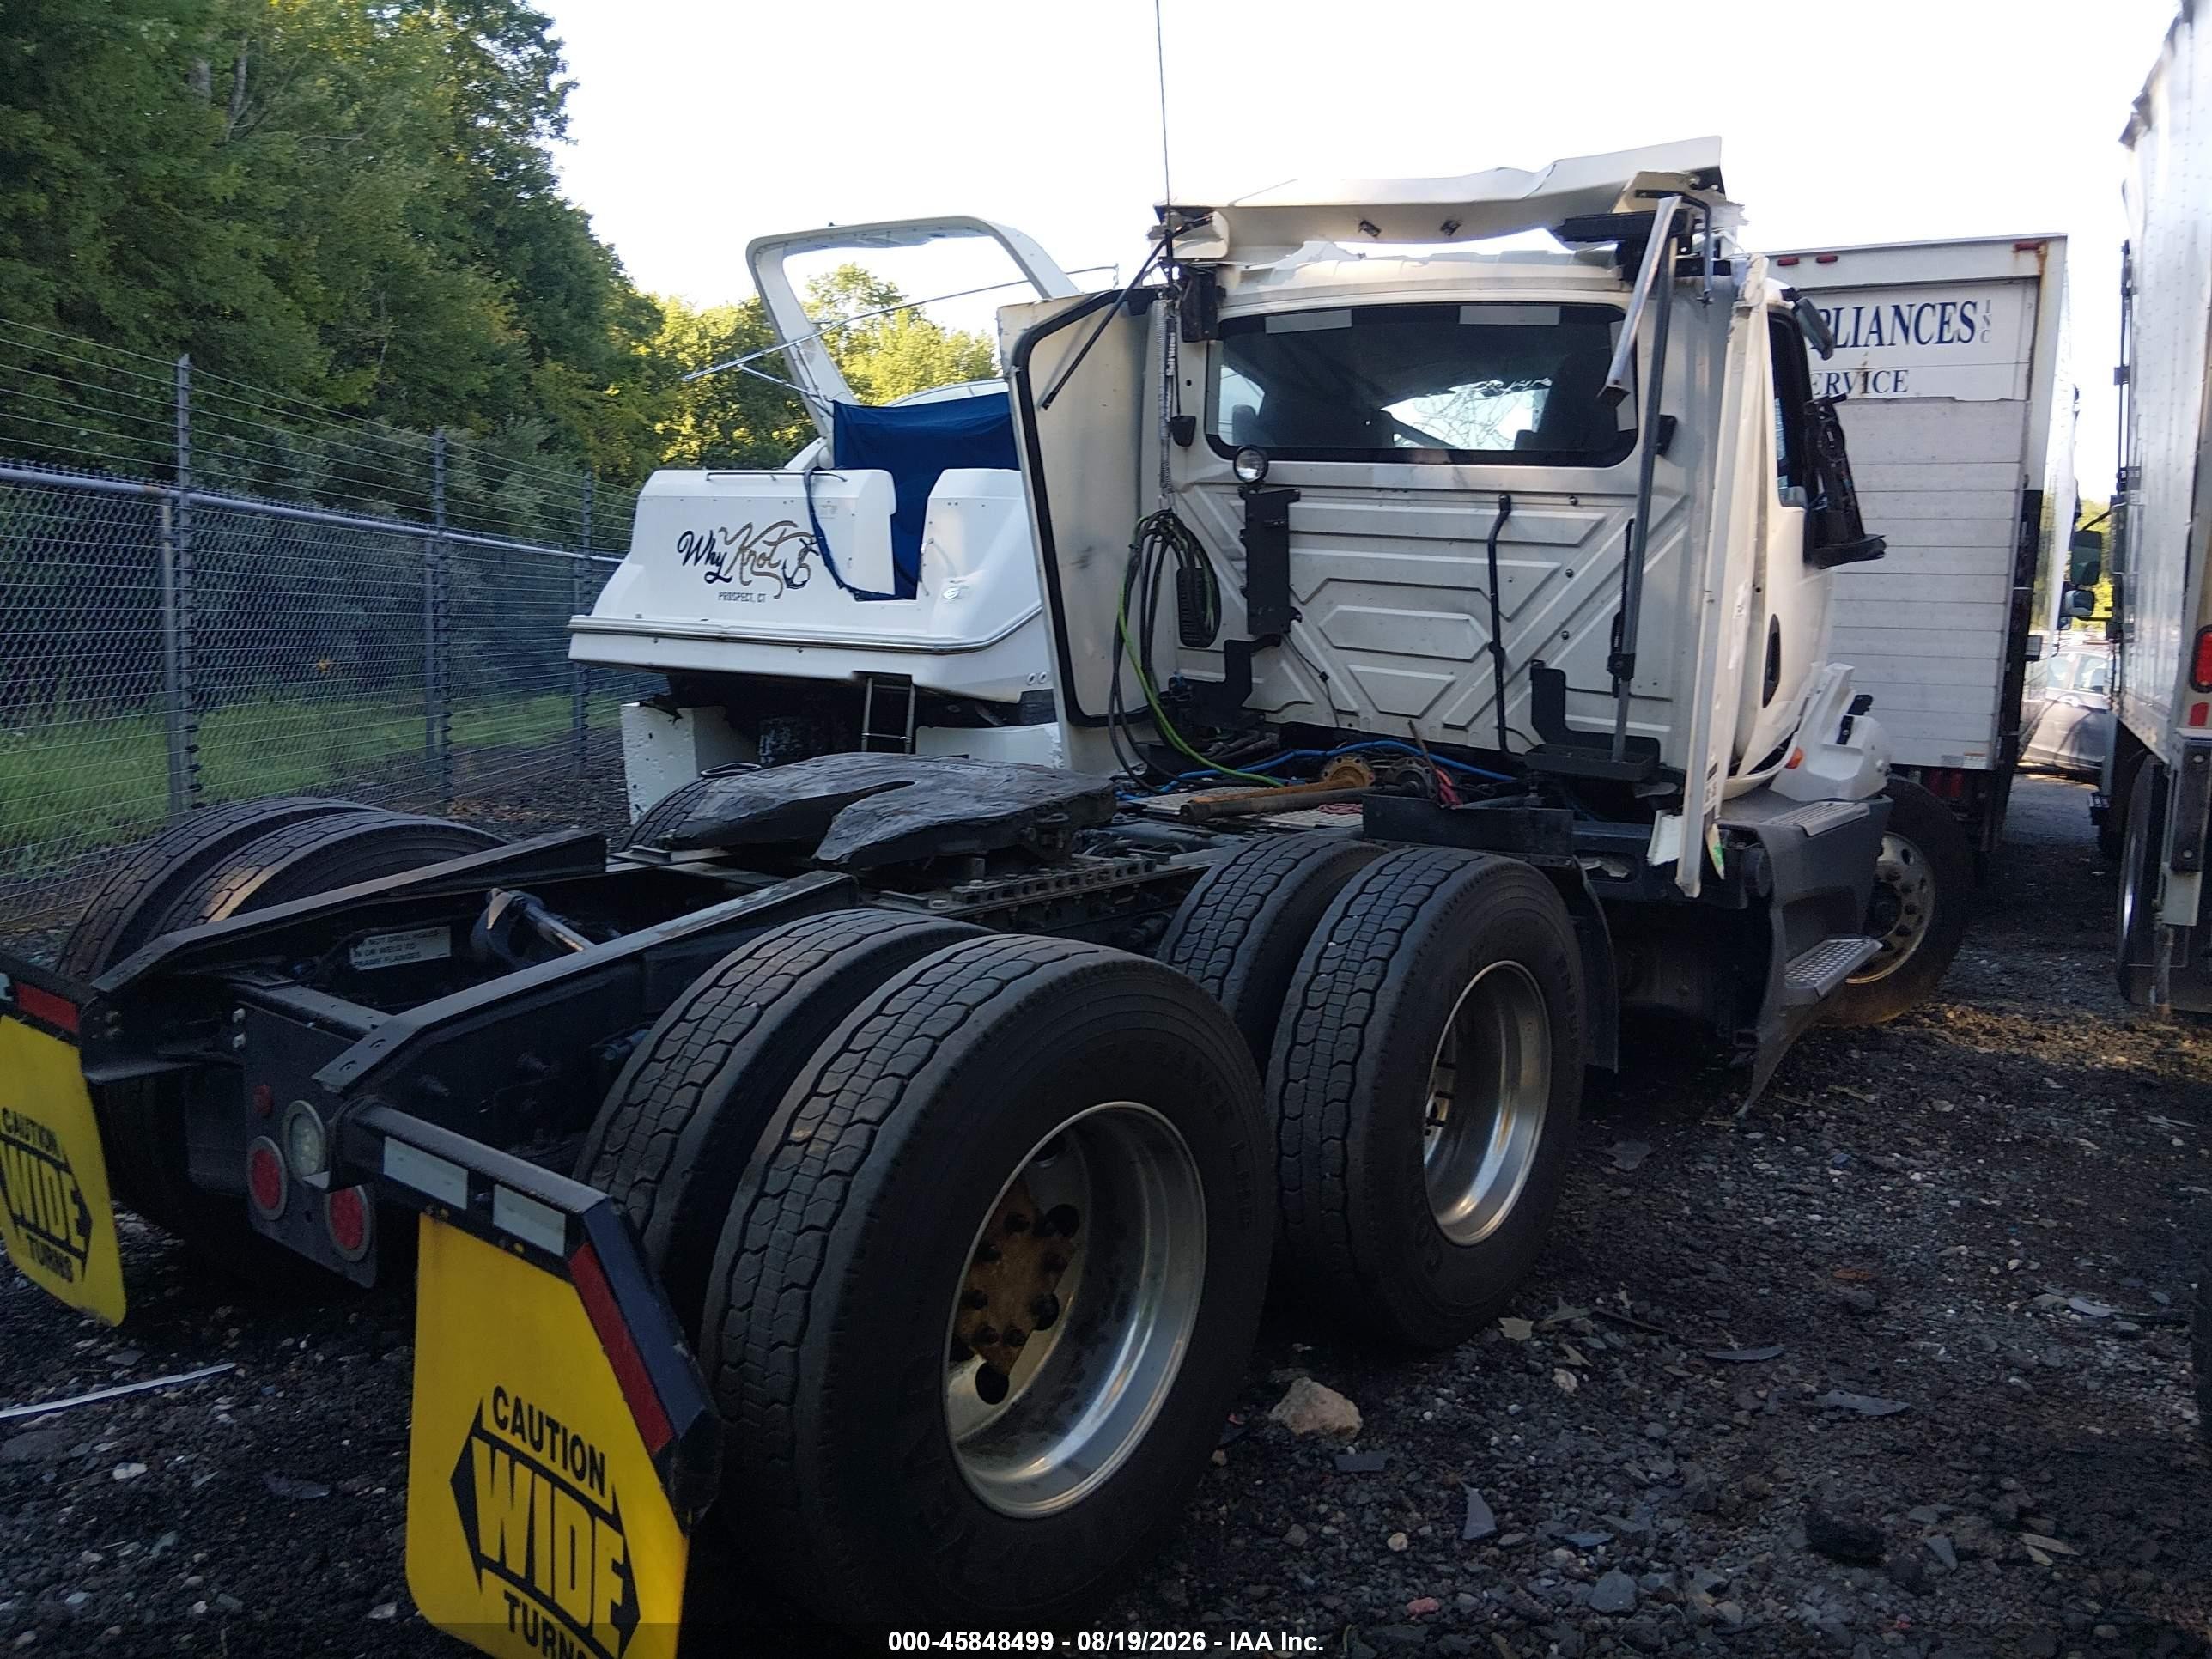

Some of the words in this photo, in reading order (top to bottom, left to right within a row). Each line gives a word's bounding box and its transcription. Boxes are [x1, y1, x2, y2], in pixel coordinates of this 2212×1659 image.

[678, 530, 732, 584] Why
[718, 520, 799, 599] Knot
[492, 1385, 605, 1498] CAUTION
[473, 1437, 625, 1658] WIDE
[503, 1589, 587, 1659] TUR
